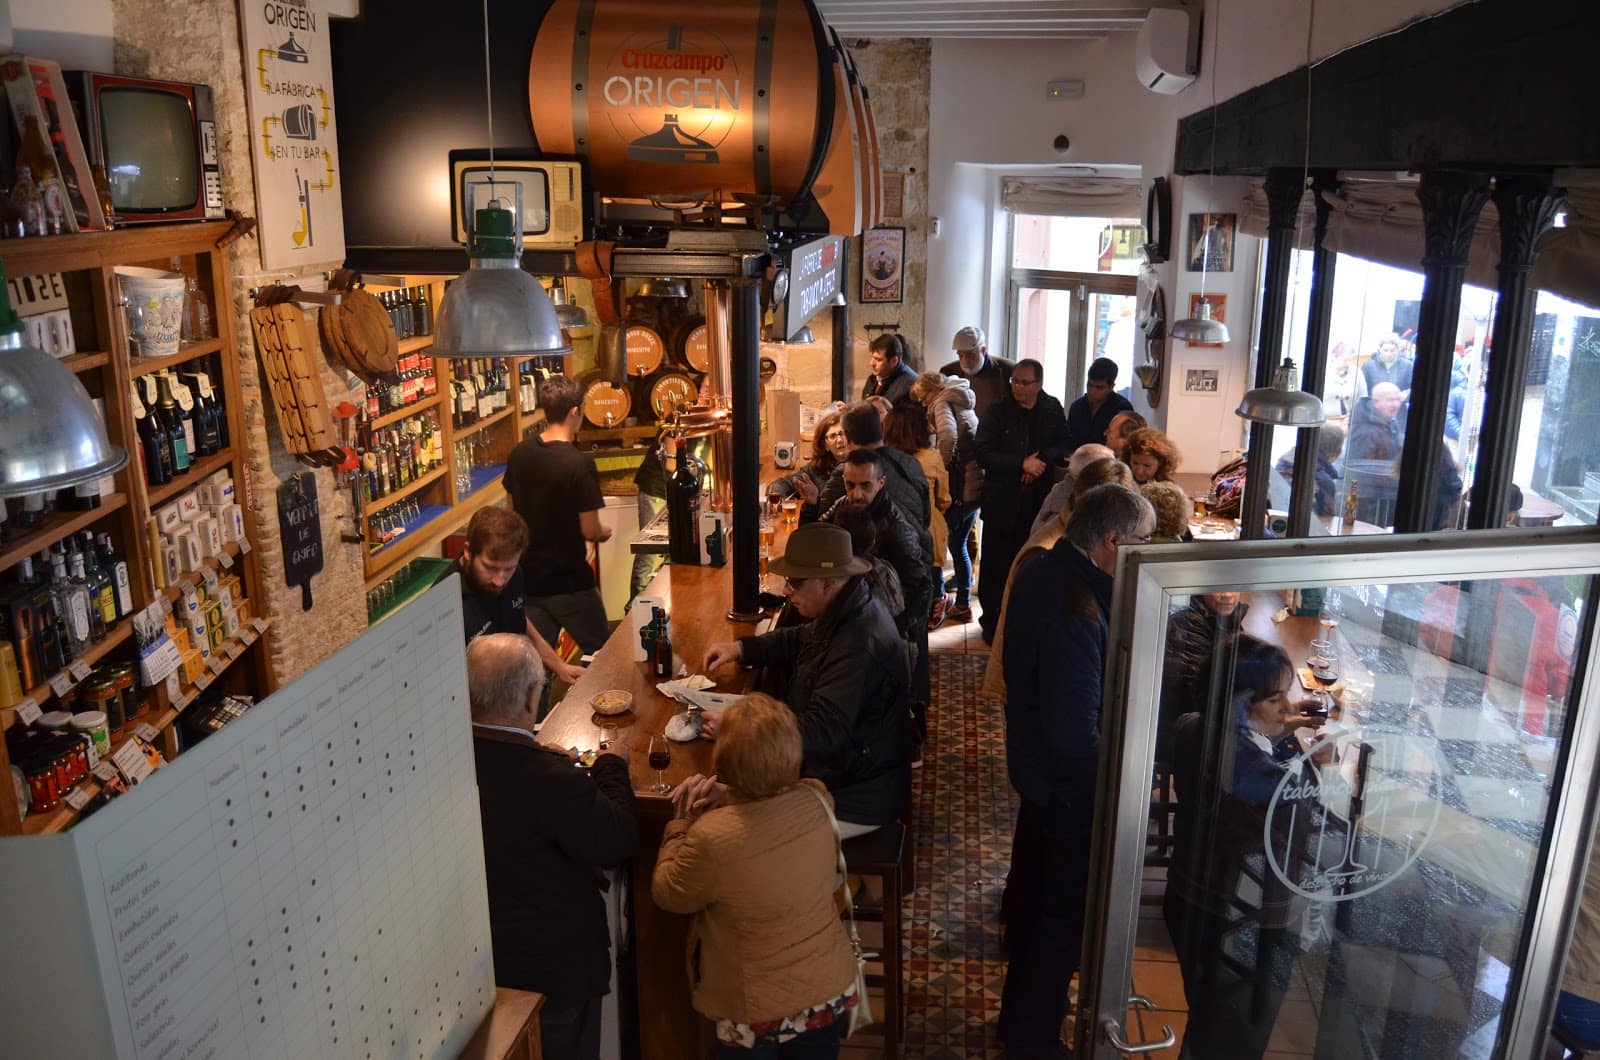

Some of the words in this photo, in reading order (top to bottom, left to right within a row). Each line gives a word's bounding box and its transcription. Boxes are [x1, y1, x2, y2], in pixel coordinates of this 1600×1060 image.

[264, 3, 316, 33] ORIGEN
[622, 49, 725, 74] Cruzcampo
[271, 82, 282, 95] LA
[603, 75, 741, 110] ORIGEN
[276, 146, 288, 159] EN
[290, 146, 302, 160] TU
[304, 146, 321, 160] BAR
